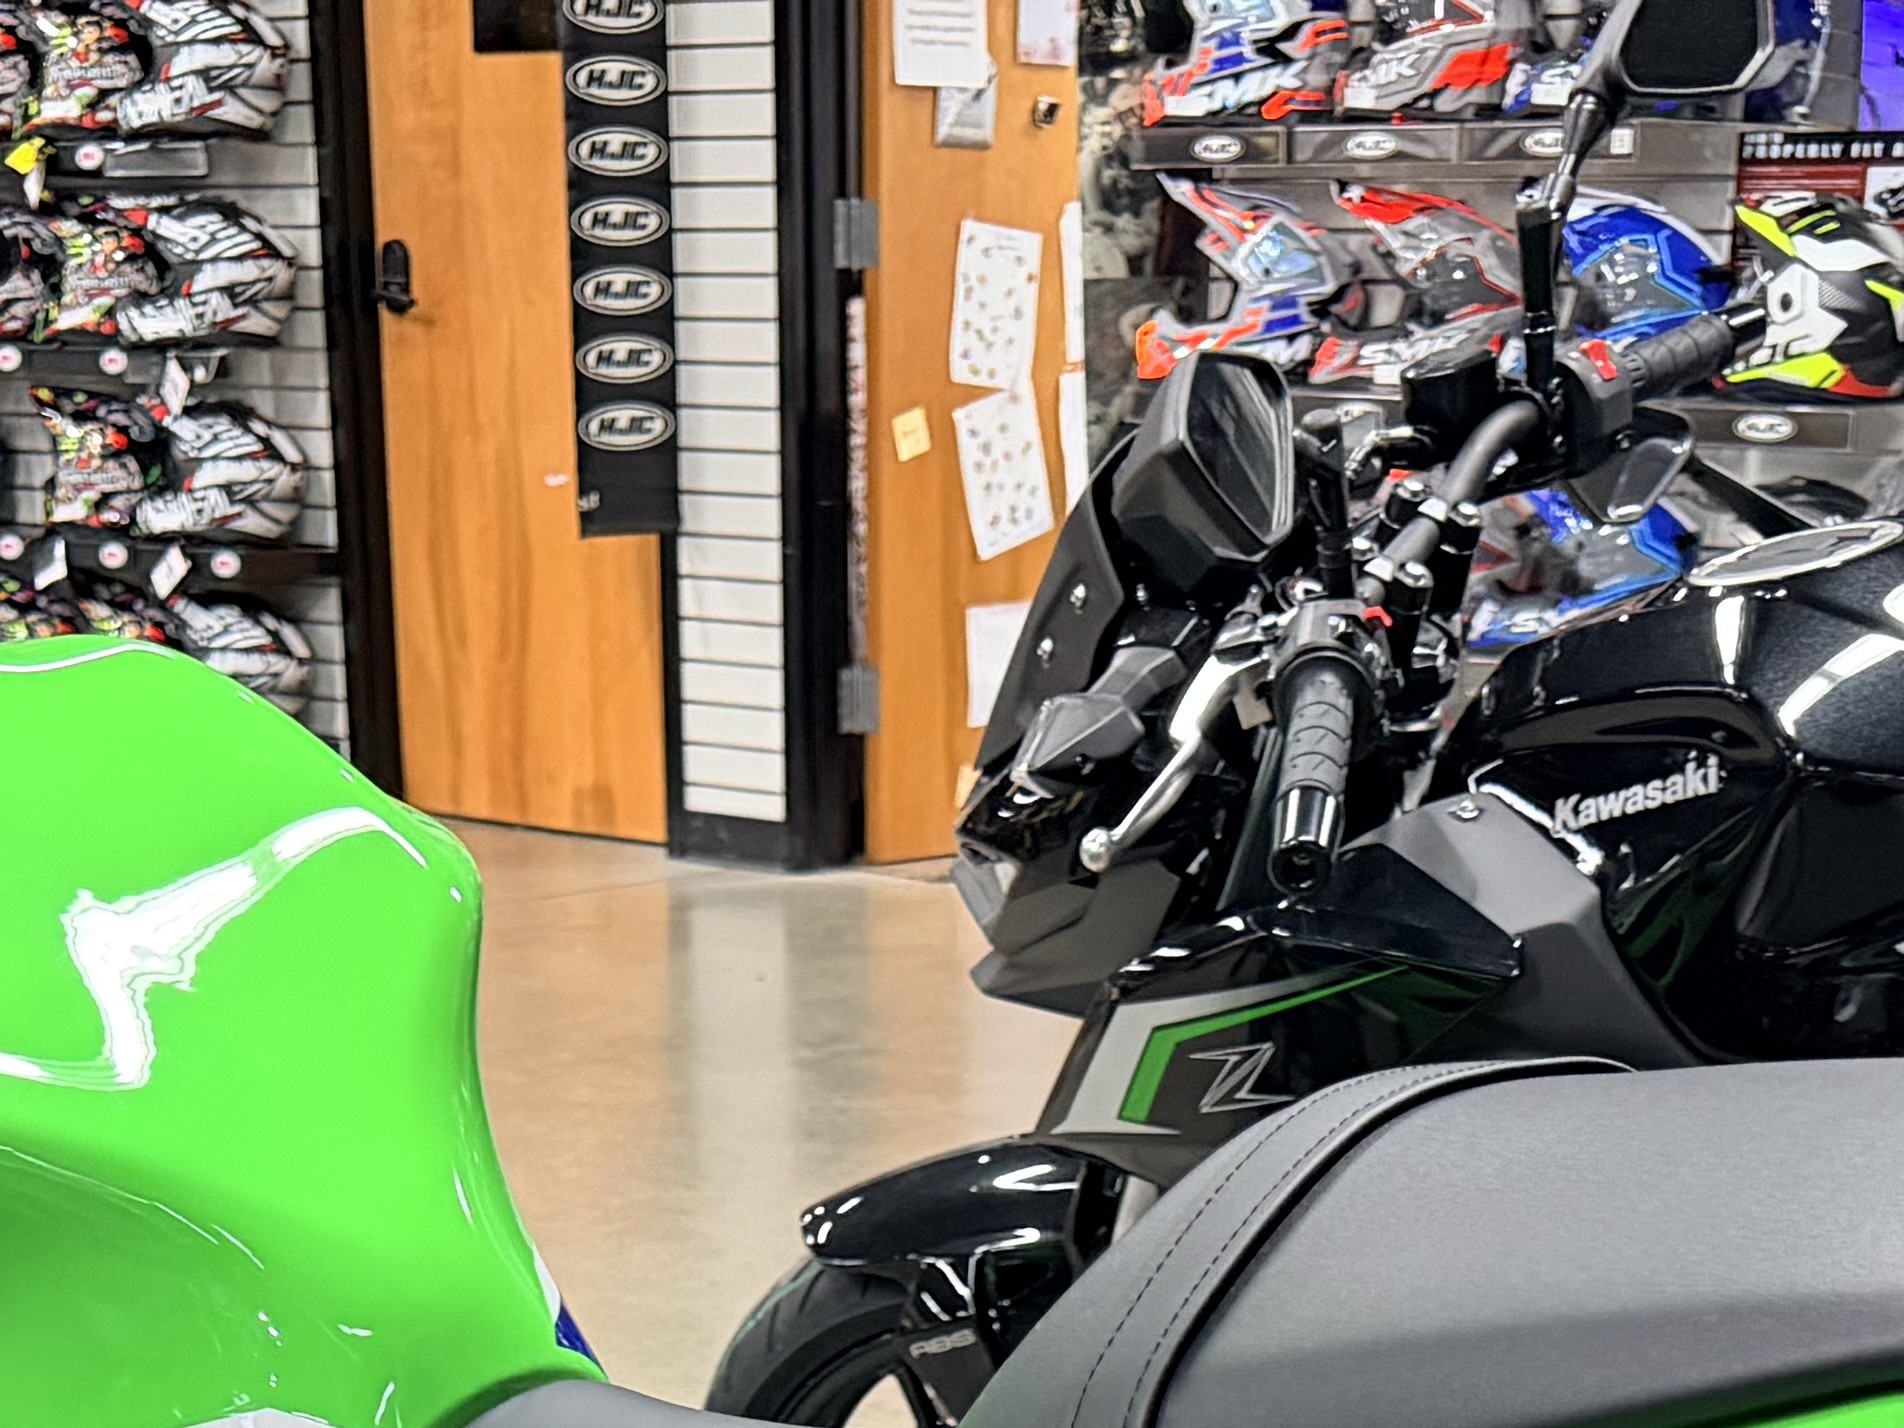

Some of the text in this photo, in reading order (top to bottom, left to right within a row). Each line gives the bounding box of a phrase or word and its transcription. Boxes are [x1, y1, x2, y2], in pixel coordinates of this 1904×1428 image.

[586, 68, 646, 90] HJC
[588, 140, 649, 161] HJC
[591, 211, 651, 231] HJC
[593, 280, 652, 300] HJC
[595, 348, 653, 368] HJC
[598, 415, 655, 437] HJC
[1553, 750, 1721, 833] Kawasaki
[1187, 1040, 1297, 1114] Z
